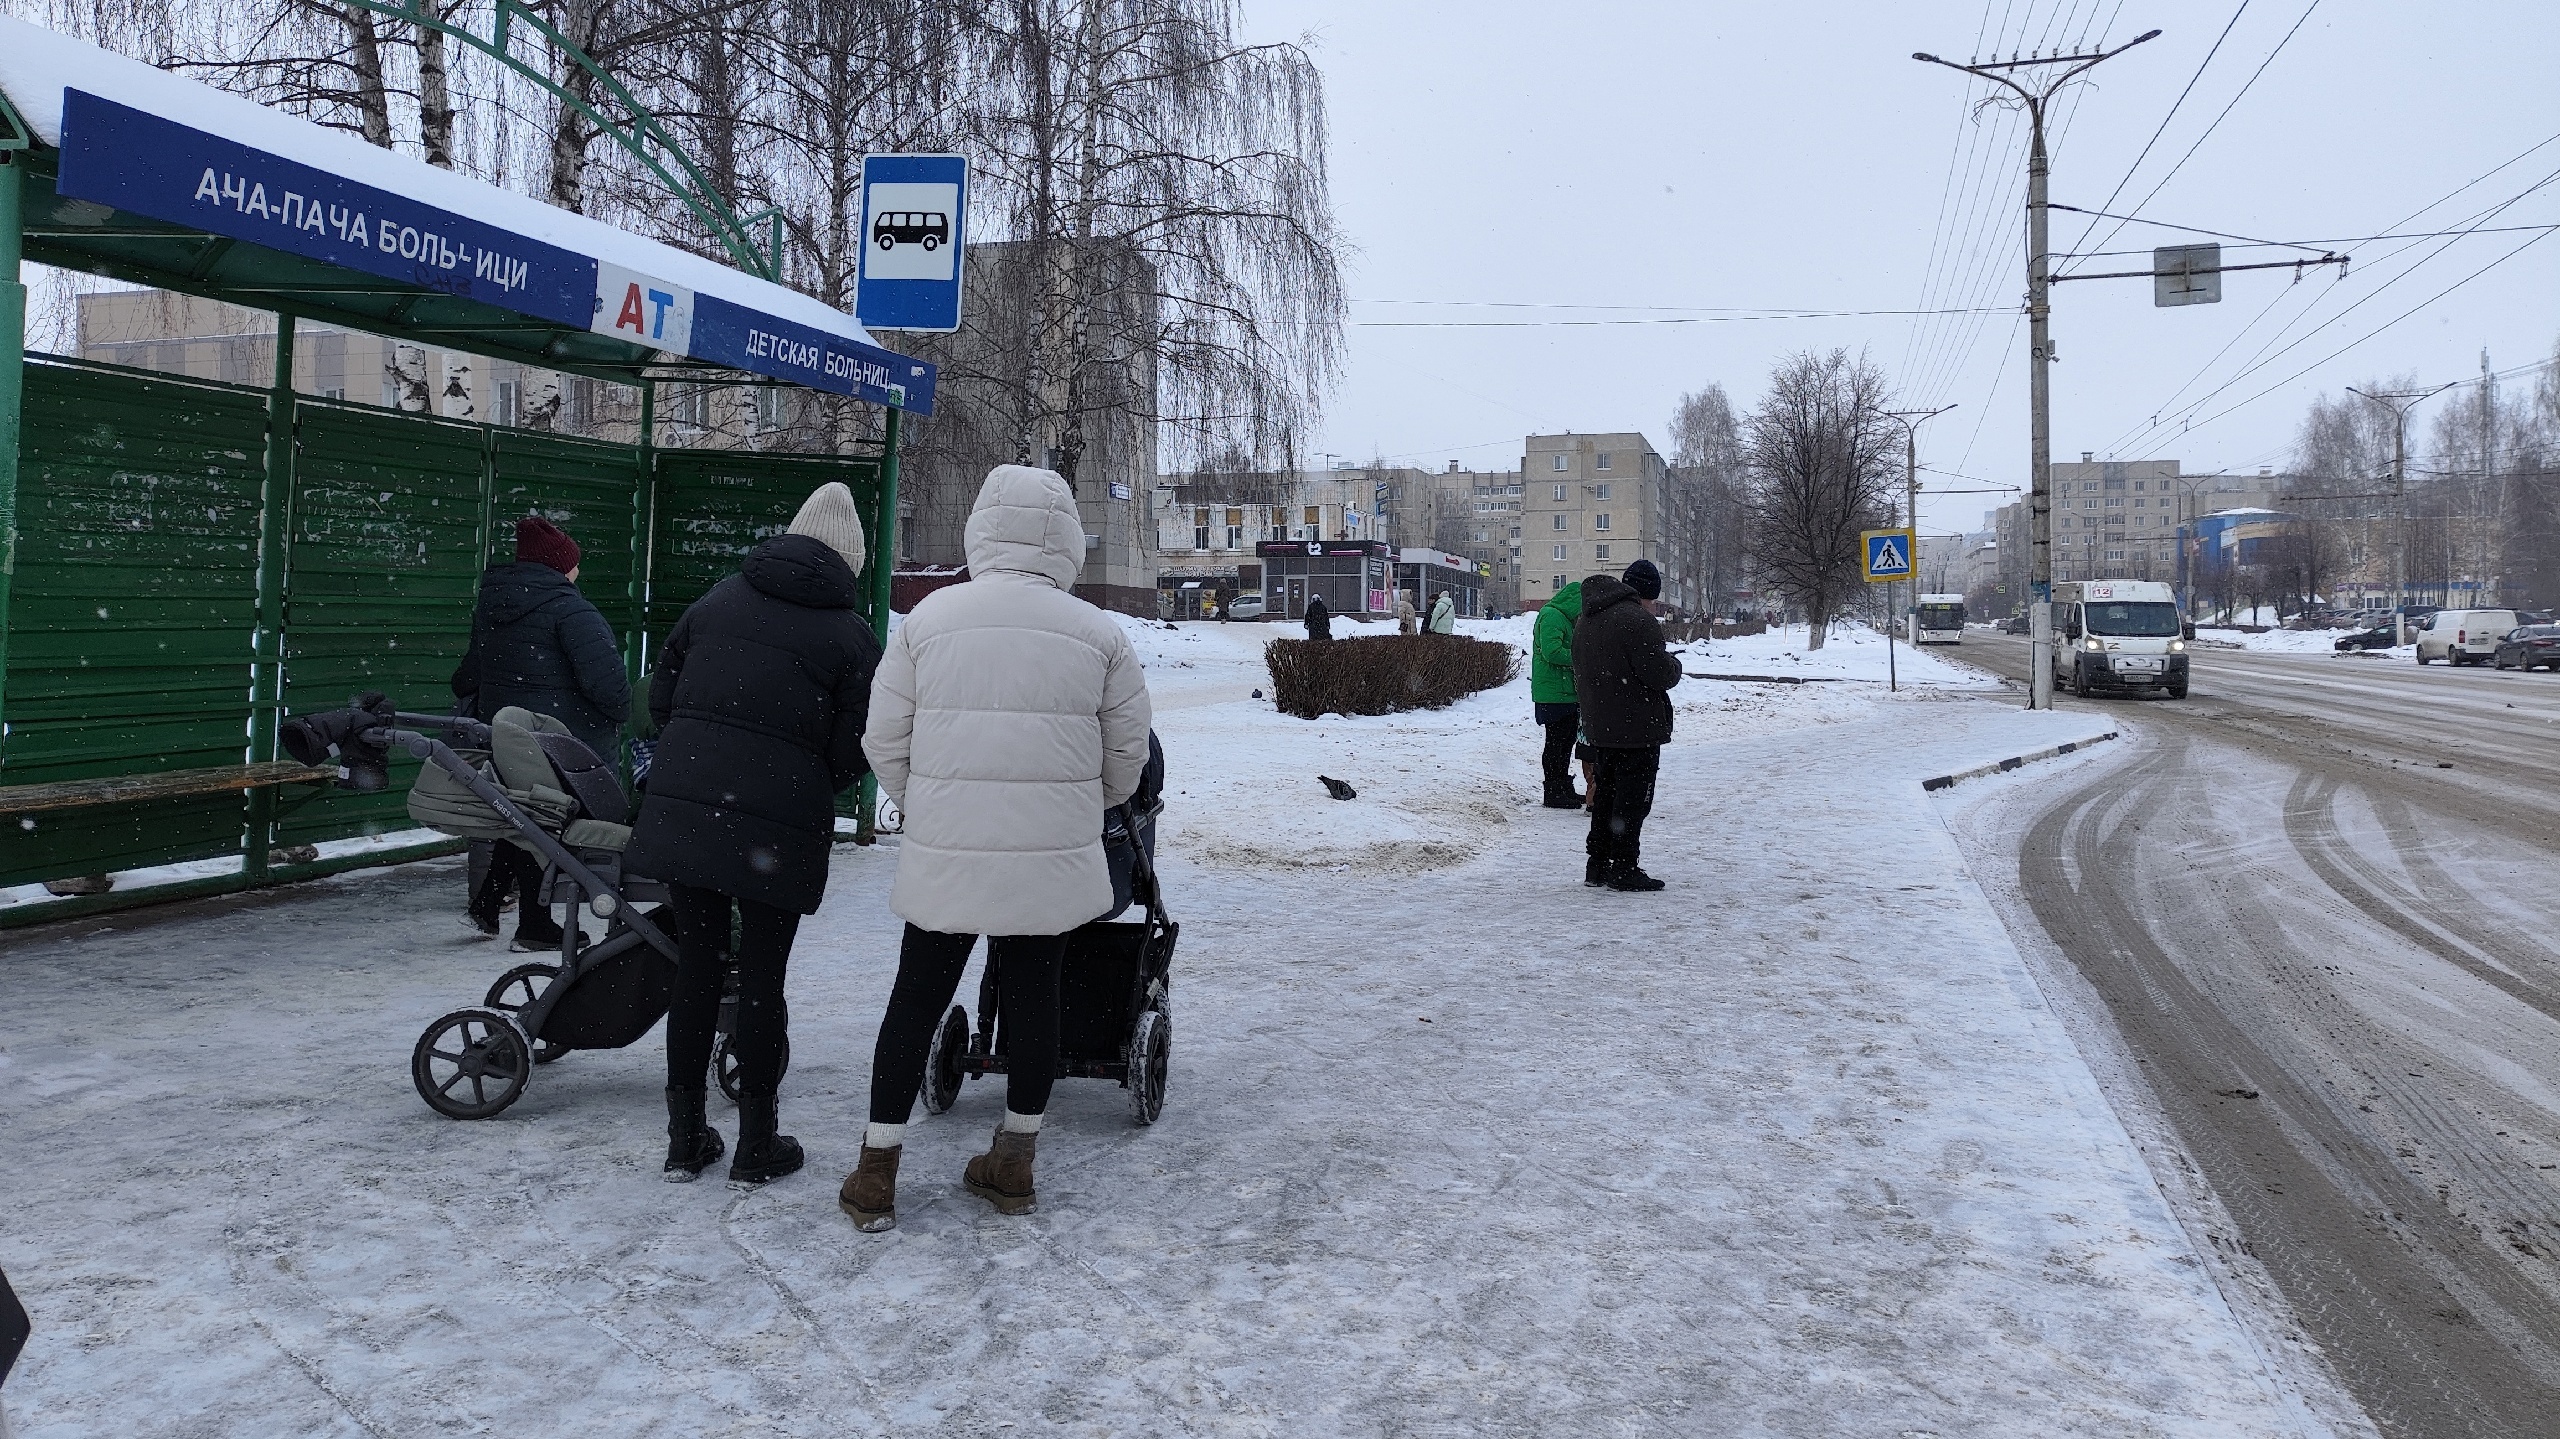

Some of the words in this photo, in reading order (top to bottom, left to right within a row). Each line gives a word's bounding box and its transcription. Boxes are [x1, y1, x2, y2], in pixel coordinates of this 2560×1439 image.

[194, 167, 369, 247] АЧА-ПАЧА
[745, 329, 819, 371] ДЕТСКАЯ
[493, 799, 511, 818] bass
